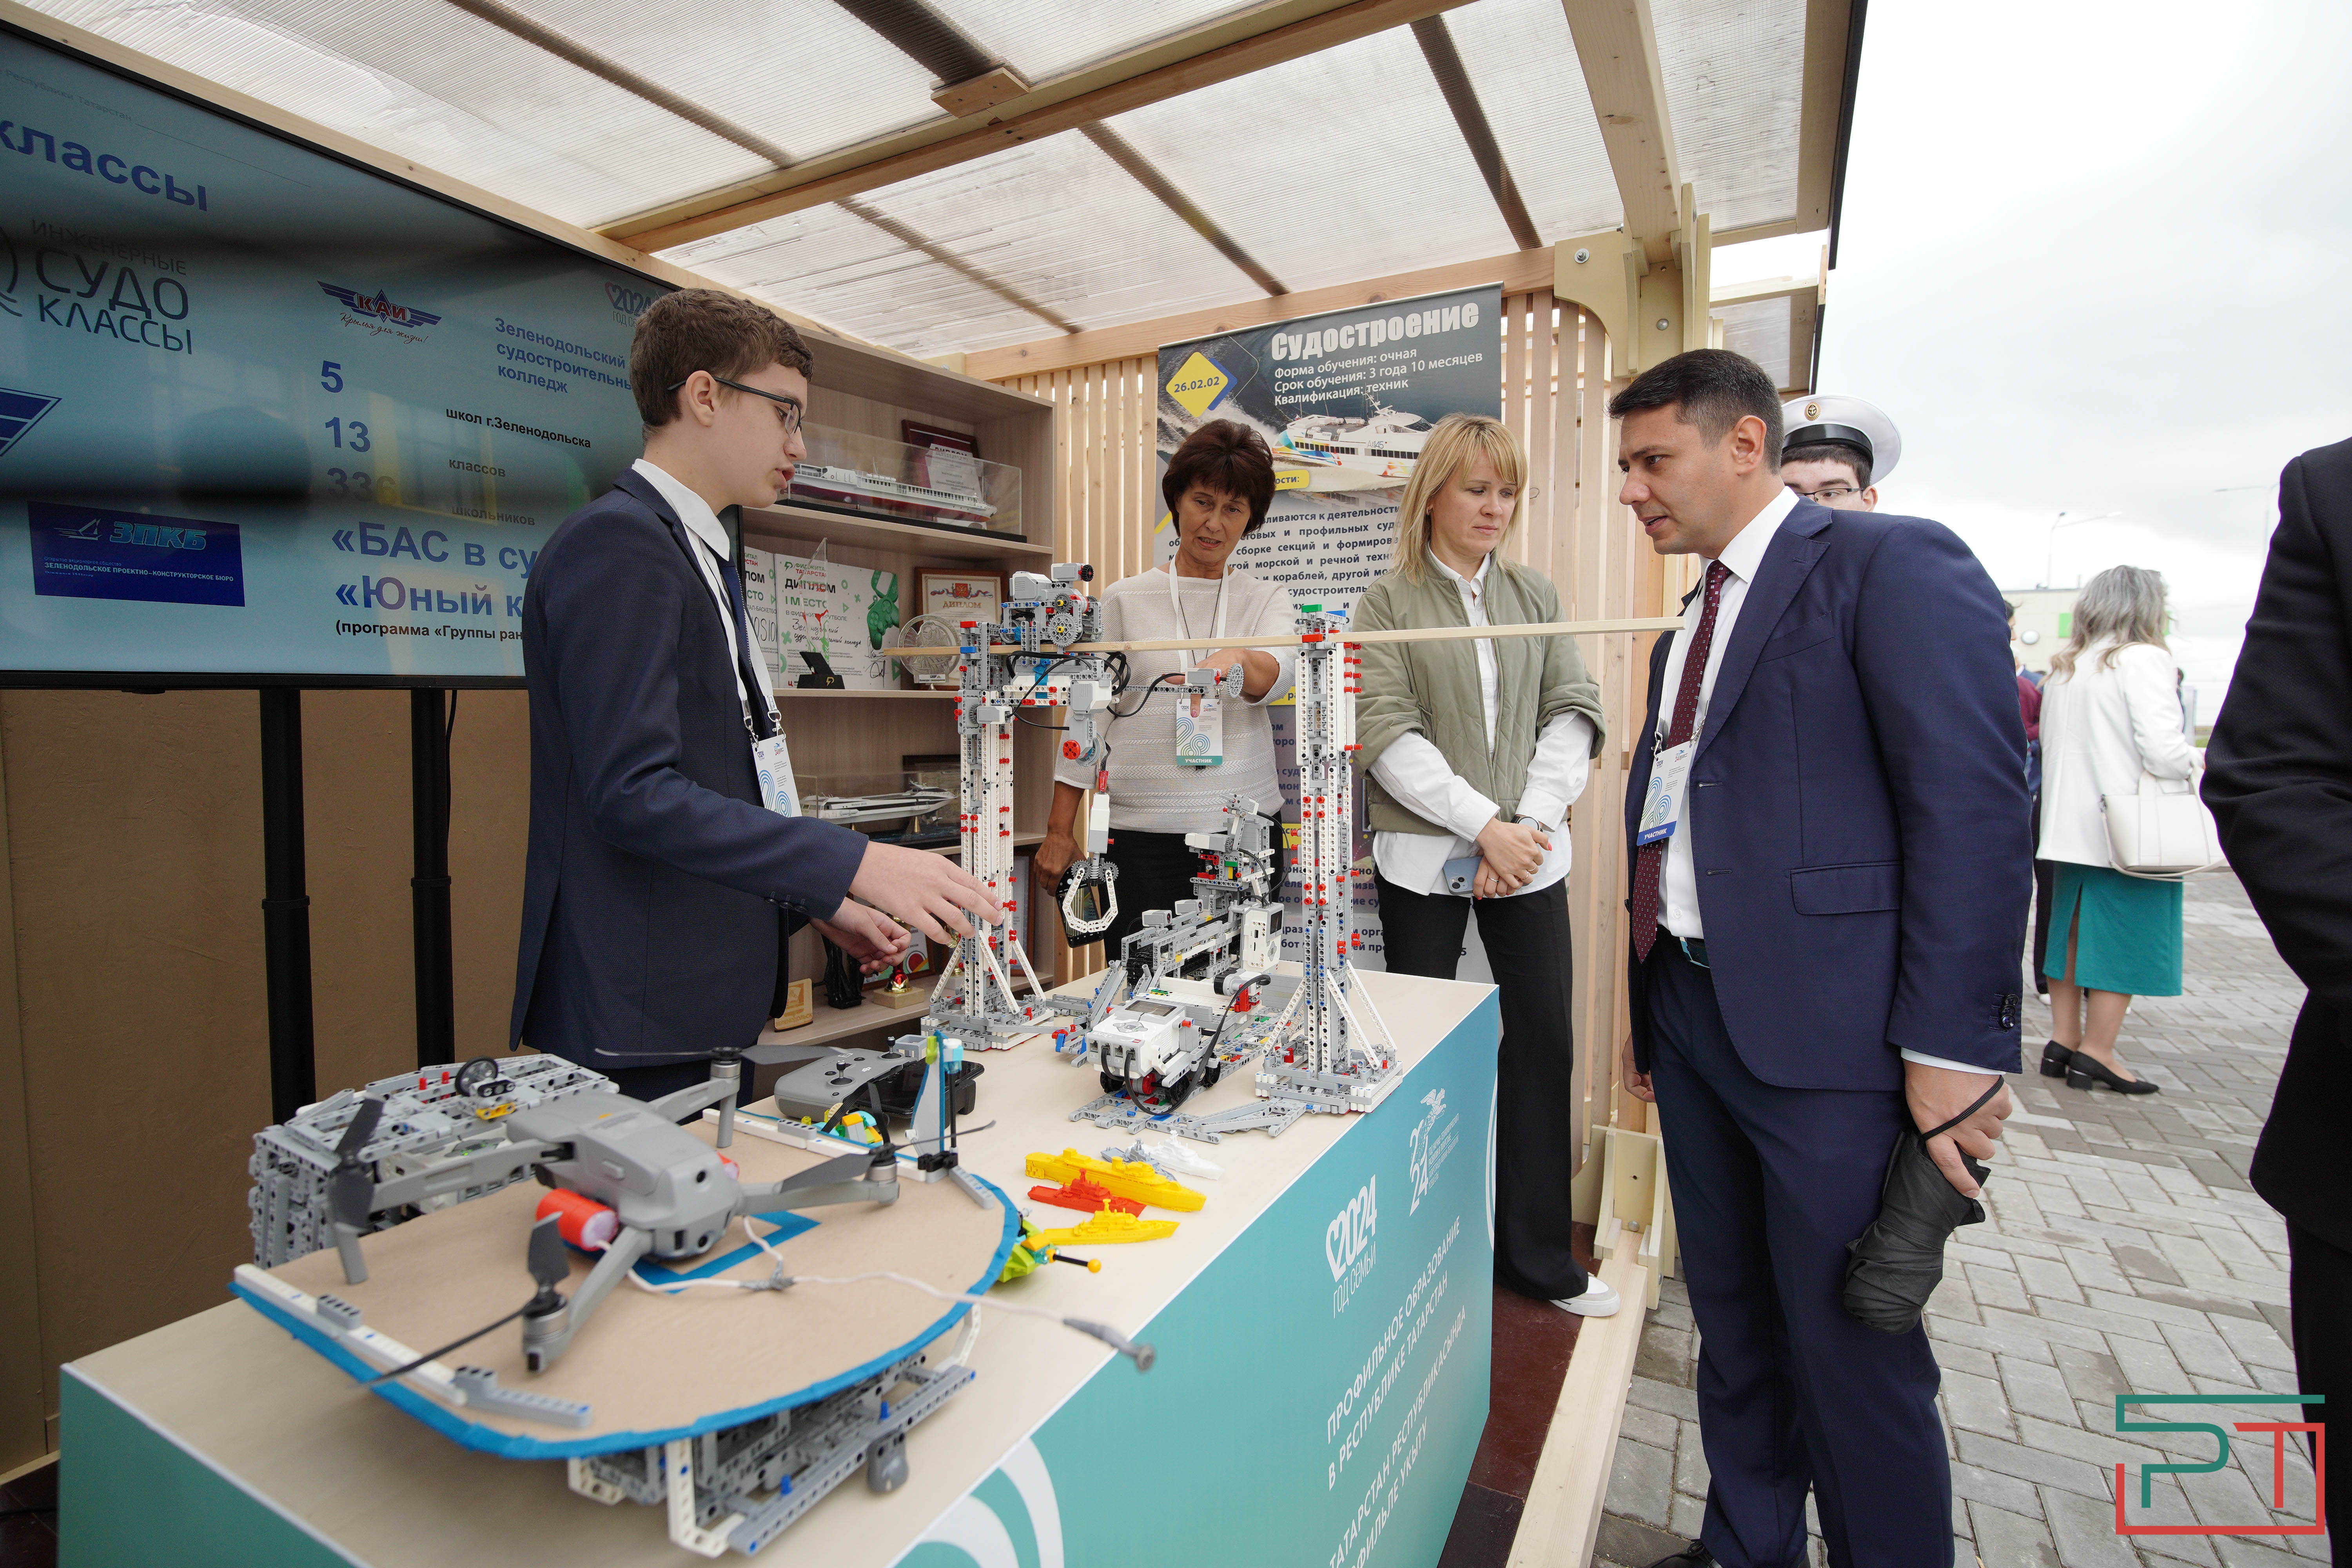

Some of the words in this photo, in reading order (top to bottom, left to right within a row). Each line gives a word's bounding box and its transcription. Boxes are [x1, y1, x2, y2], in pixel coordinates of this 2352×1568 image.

[32, 219, 186, 276] ИНЖЕНЕРНЫЕ
[36, 247, 189, 320] СУДО
[358, 294, 408, 323] КАИ
[613, 311, 627, 327] ГОД
[38, 294, 192, 355] КЛАССЫ
[340, 312, 375, 329] Крылья
[370, 326, 394, 336] для
[396, 330, 429, 345] жизни!
[1272, 301, 1479, 361] Судостроение
[495, 317, 626, 368] Зеленодольский
[321, 361, 343, 393] 5
[497, 343, 632, 390] судостроительны
[1274, 365, 1314, 380] Форма
[1318, 356, 1377, 376] обучения:
[1379, 348, 1417, 362] очная
[1274, 379, 1303, 394] Срок
[1307, 370, 1367, 390] обучения:
[1369, 367, 1376, 377] 3
[1379, 363, 1407, 378] года
[1412, 361, 1425, 372] 10
[1428, 352, 1483, 371] месяцев
[498, 365, 568, 394] колледж
[1173, 376, 1220, 394] 26.02.02
[1274, 386, 1366, 407] Квалификация:
[1366, 379, 1409, 394] техник
[325, 417, 371, 453] 13
[446, 408, 482, 425] школ
[486, 417, 592, 448] г.Зеленодольска
[449, 457, 506, 478] классов
[1275, 475, 1300, 486] ости:
[452, 506, 535, 526] школьников
[1259, 513, 1316, 524] вливаются
[110, 521, 207, 550] ЗПКБ
[1169, 537, 1180, 547] об
[1299, 524, 1369, 538] профильных
[1377, 521, 1400, 532] суд
[1236, 545, 1271, 556] сборке
[1278, 541, 1316, 554] секций
[1336, 535, 1399, 550] формиров
[332, 521, 449, 563] «БАС
[464, 543, 486, 566] в
[499, 547, 538, 579] су
[744, 552, 758, 561] ИТАЛ
[1228, 561, 1249, 570] гой
[1255, 556, 1299, 569] морской
[1320, 554, 1360, 567] речной
[1366, 553, 1392, 563] техн
[44, 562, 111, 572] ЗЕЛЕНОДОЛЬСКОЕ
[745, 570, 765, 584] ЛОМ
[795, 568, 827, 577] ТААРСТА
[1273, 570, 1328, 582] кораблей,
[1332, 568, 1370, 581] другой
[1374, 568, 1389, 577] мо
[335, 575, 492, 616] «Юный
[506, 595, 523, 618] к
[746, 589, 764, 601] СТО
[1288, 586, 1368, 597] судостроитель
[746, 604, 777, 615] ТАЛ-БАСКЕТБО
[942, 601, 982, 609] ДИПЛОМ
[336, 619, 430, 637] (программа
[434, 625, 495, 640] «Группы
[500, 630, 524, 641] ран
[1273, 738, 1296, 748] торо
[1282, 768, 1300, 777] суд
[1644, 828, 1667, 840] УЧАСТНИК
[1282, 866, 1303, 874] кона
[1368, 898, 1379, 908] су
[1282, 926, 1303, 935] раз
[1361, 929, 1384, 938] орг
[1281, 938, 1299, 948] бот
[1353, 942, 1365, 951] ей
[1368, 944, 1385, 953] пр
[1410, 1152, 1428, 1217] 24
[1326, 1174, 1377, 1282] 2024
[1333, 1276, 1349, 1318] ГОД
[1351, 1241, 1376, 1295] СЕМЬИ
[1327, 1305, 1403, 1445] ПРОФИЛЬНОЕ
[1405, 1215, 1461, 1318] ОБРАЗОВАНИЕ
[1328, 1462, 1336, 1491] В
[1339, 1343, 1405, 1473] РЕСПУБЛИКЕ
[1407, 1270, 1448, 1355] ТАТАРСТАН
[1329, 1454, 1390, 1568] ТАТАРСТАН
[1392, 1305, 1466, 1466] РЕСПУБЛИКАСЫНДА
[1352, 1483, 1399, 1568] ФИЛЬЛЕ
[1401, 1416, 1427, 1486] УКЫТУ
